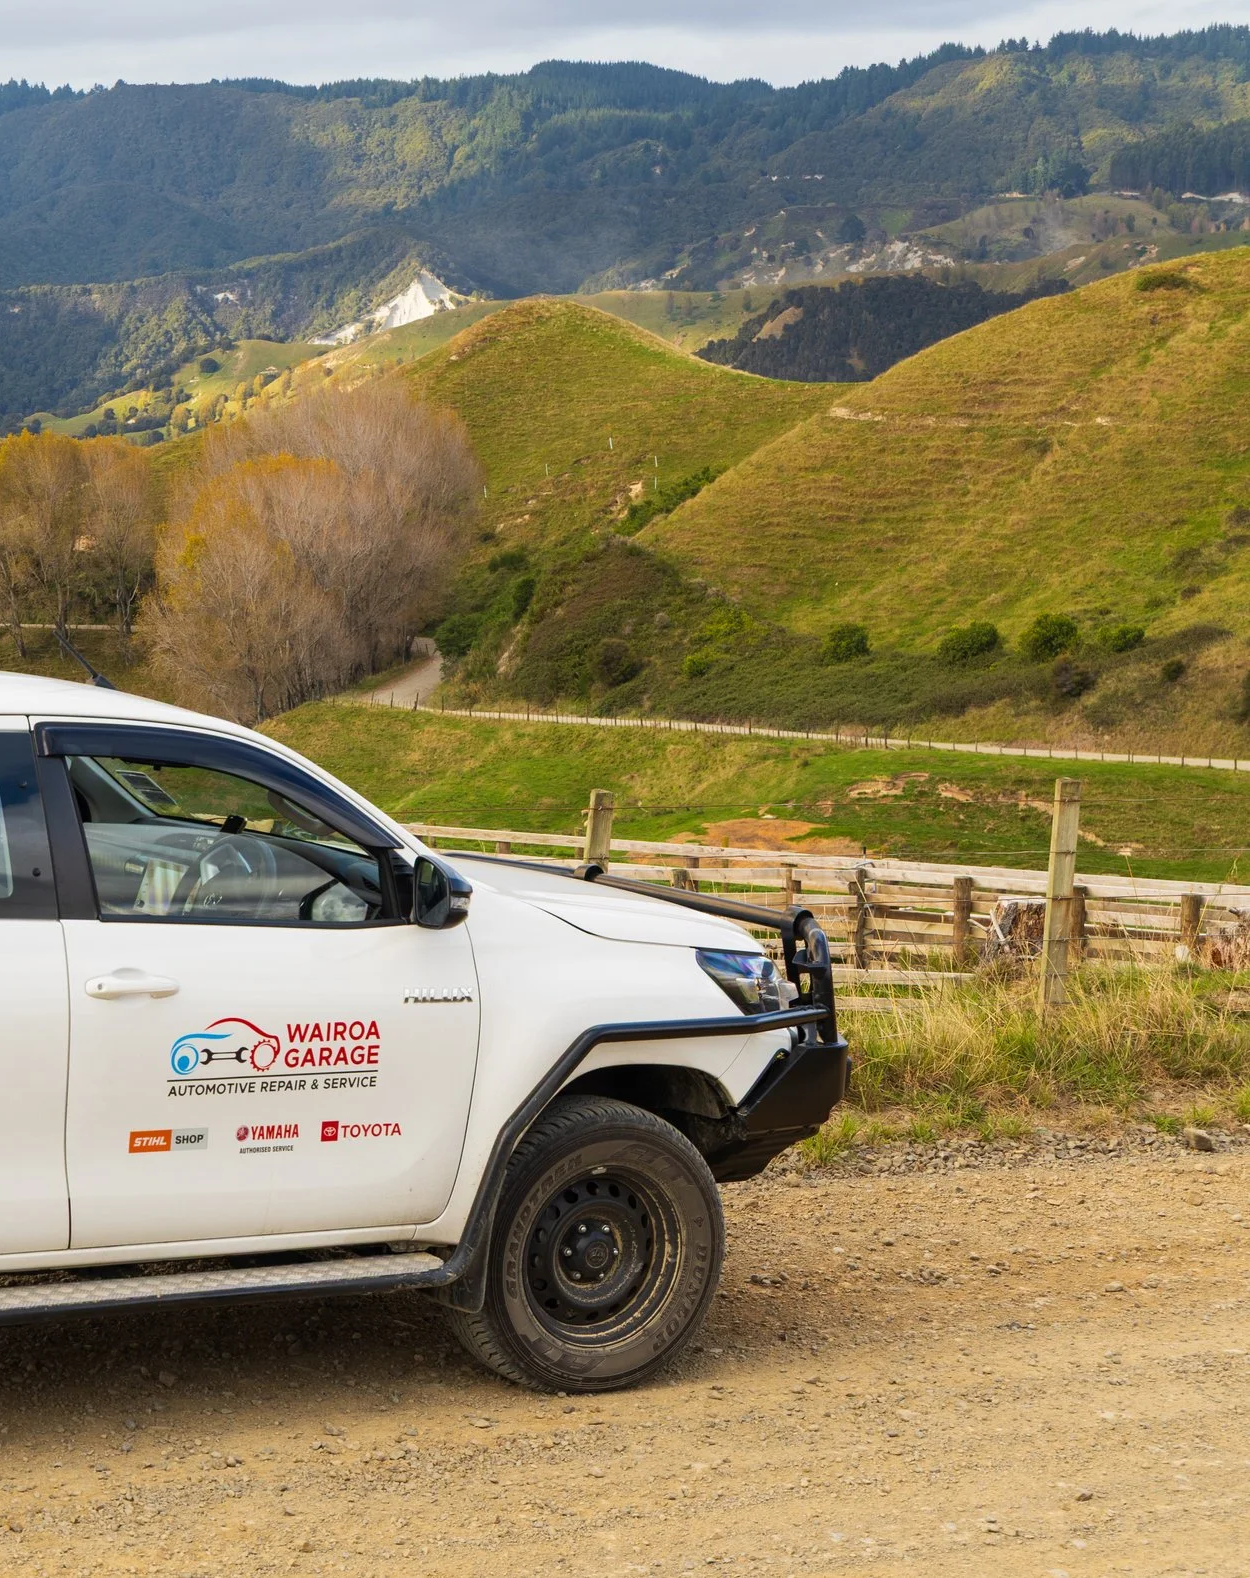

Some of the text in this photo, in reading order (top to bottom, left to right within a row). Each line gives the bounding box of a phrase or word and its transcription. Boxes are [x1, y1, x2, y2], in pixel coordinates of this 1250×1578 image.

[403, 986, 473, 1003] HILUX
[286, 1020, 381, 1043] WAIROA
[284, 1045, 381, 1068] GARAGE
[167, 1076, 377, 1097] AUTOMOTIVE REPAIR & SERVICE
[251, 1124, 299, 1141] YAMAHA
[341, 1123, 402, 1139] TOYOTA
[133, 1134, 204, 1147] STIHL SHOP
[239, 1146, 271, 1154] AUTHORISED
